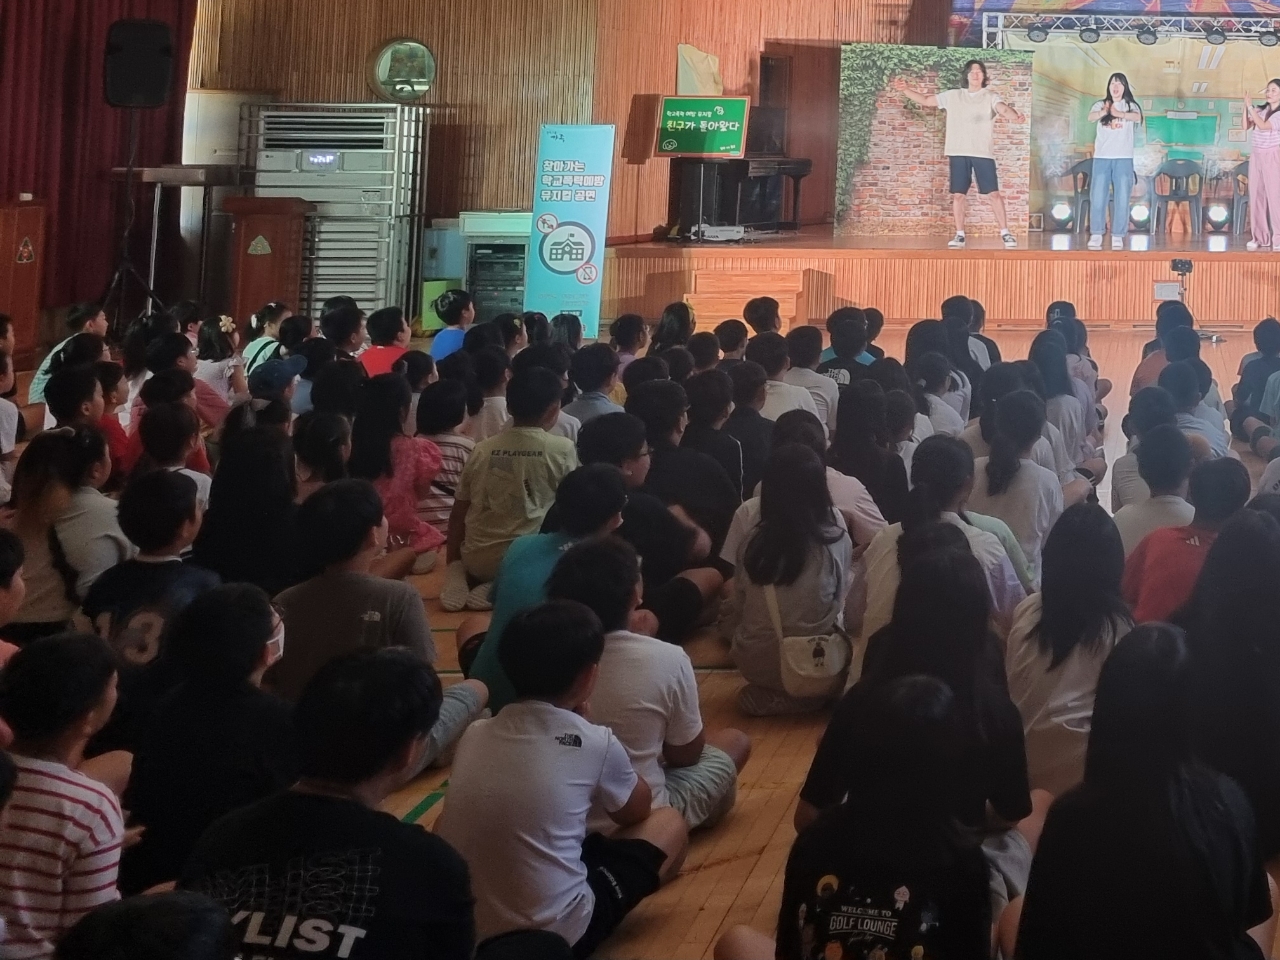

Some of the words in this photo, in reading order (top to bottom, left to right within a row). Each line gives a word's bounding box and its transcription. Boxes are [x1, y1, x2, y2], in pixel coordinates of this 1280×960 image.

[667, 121, 696, 131] 친구가
[700, 121, 740, 132] 돌아왔다
[543, 160, 585, 172] 찾아가는
[542, 175, 605, 187] 학교폭력예방
[541, 190, 572, 201] 뮤지컬
[574, 190, 596, 201] 공연
[829, 915, 856, 930] GOLF
[858, 917, 898, 936] LOUNGE
